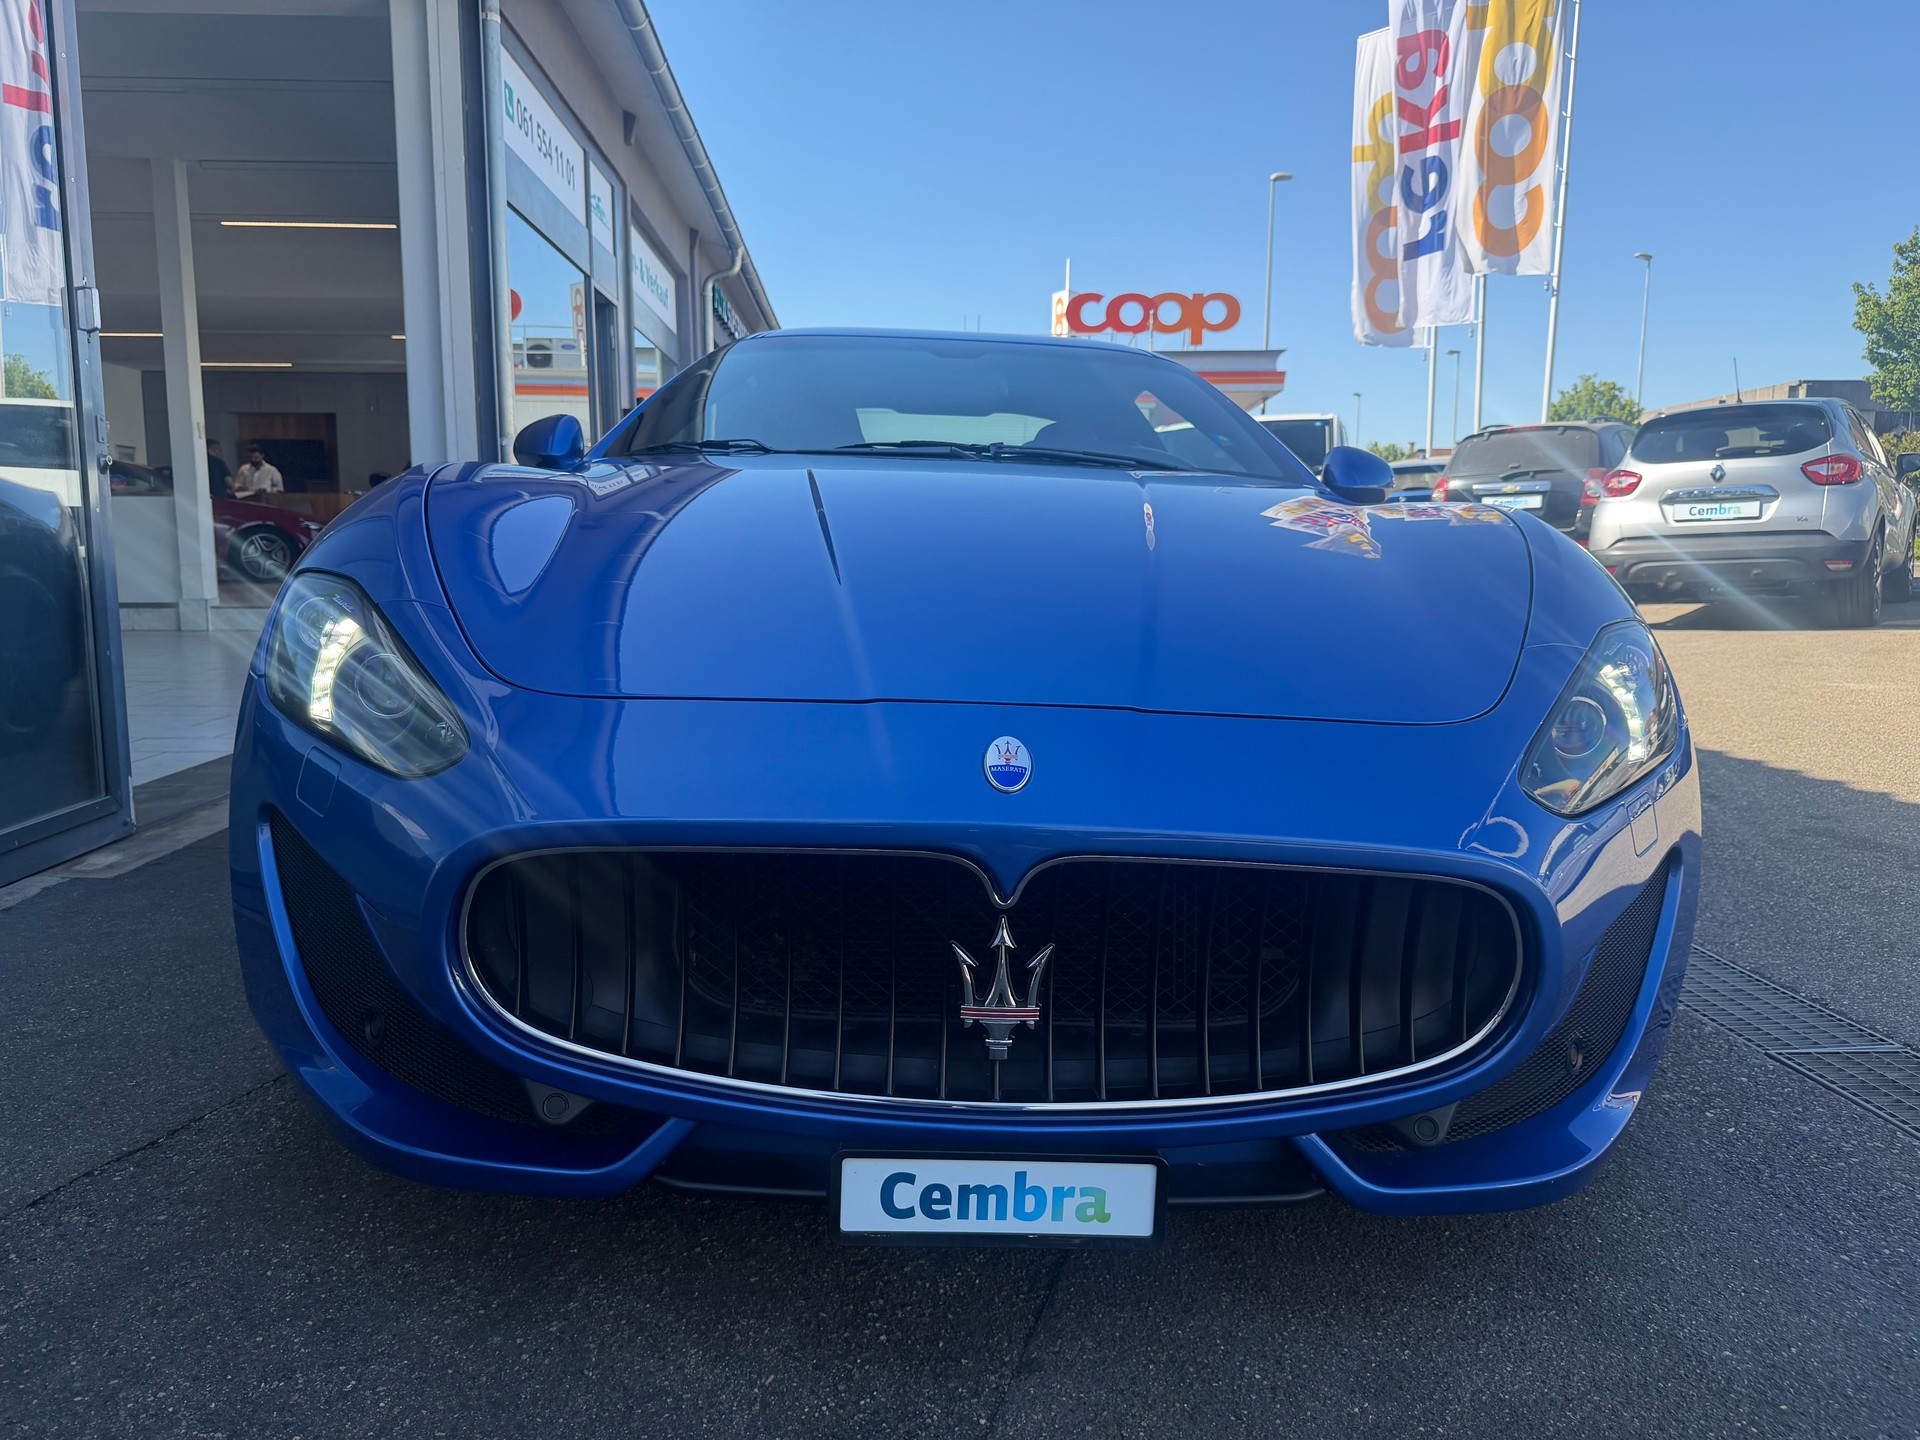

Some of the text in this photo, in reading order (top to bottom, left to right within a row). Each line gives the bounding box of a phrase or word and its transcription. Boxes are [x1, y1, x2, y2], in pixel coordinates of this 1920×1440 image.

[516, 97, 575, 192] 061 554 11 01
[1065, 292, 1241, 346] coop
[1689, 502, 1742, 516] Cembra
[990, 766, 1026, 774] MASERATI
[879, 1170, 1112, 1224] Cembra
